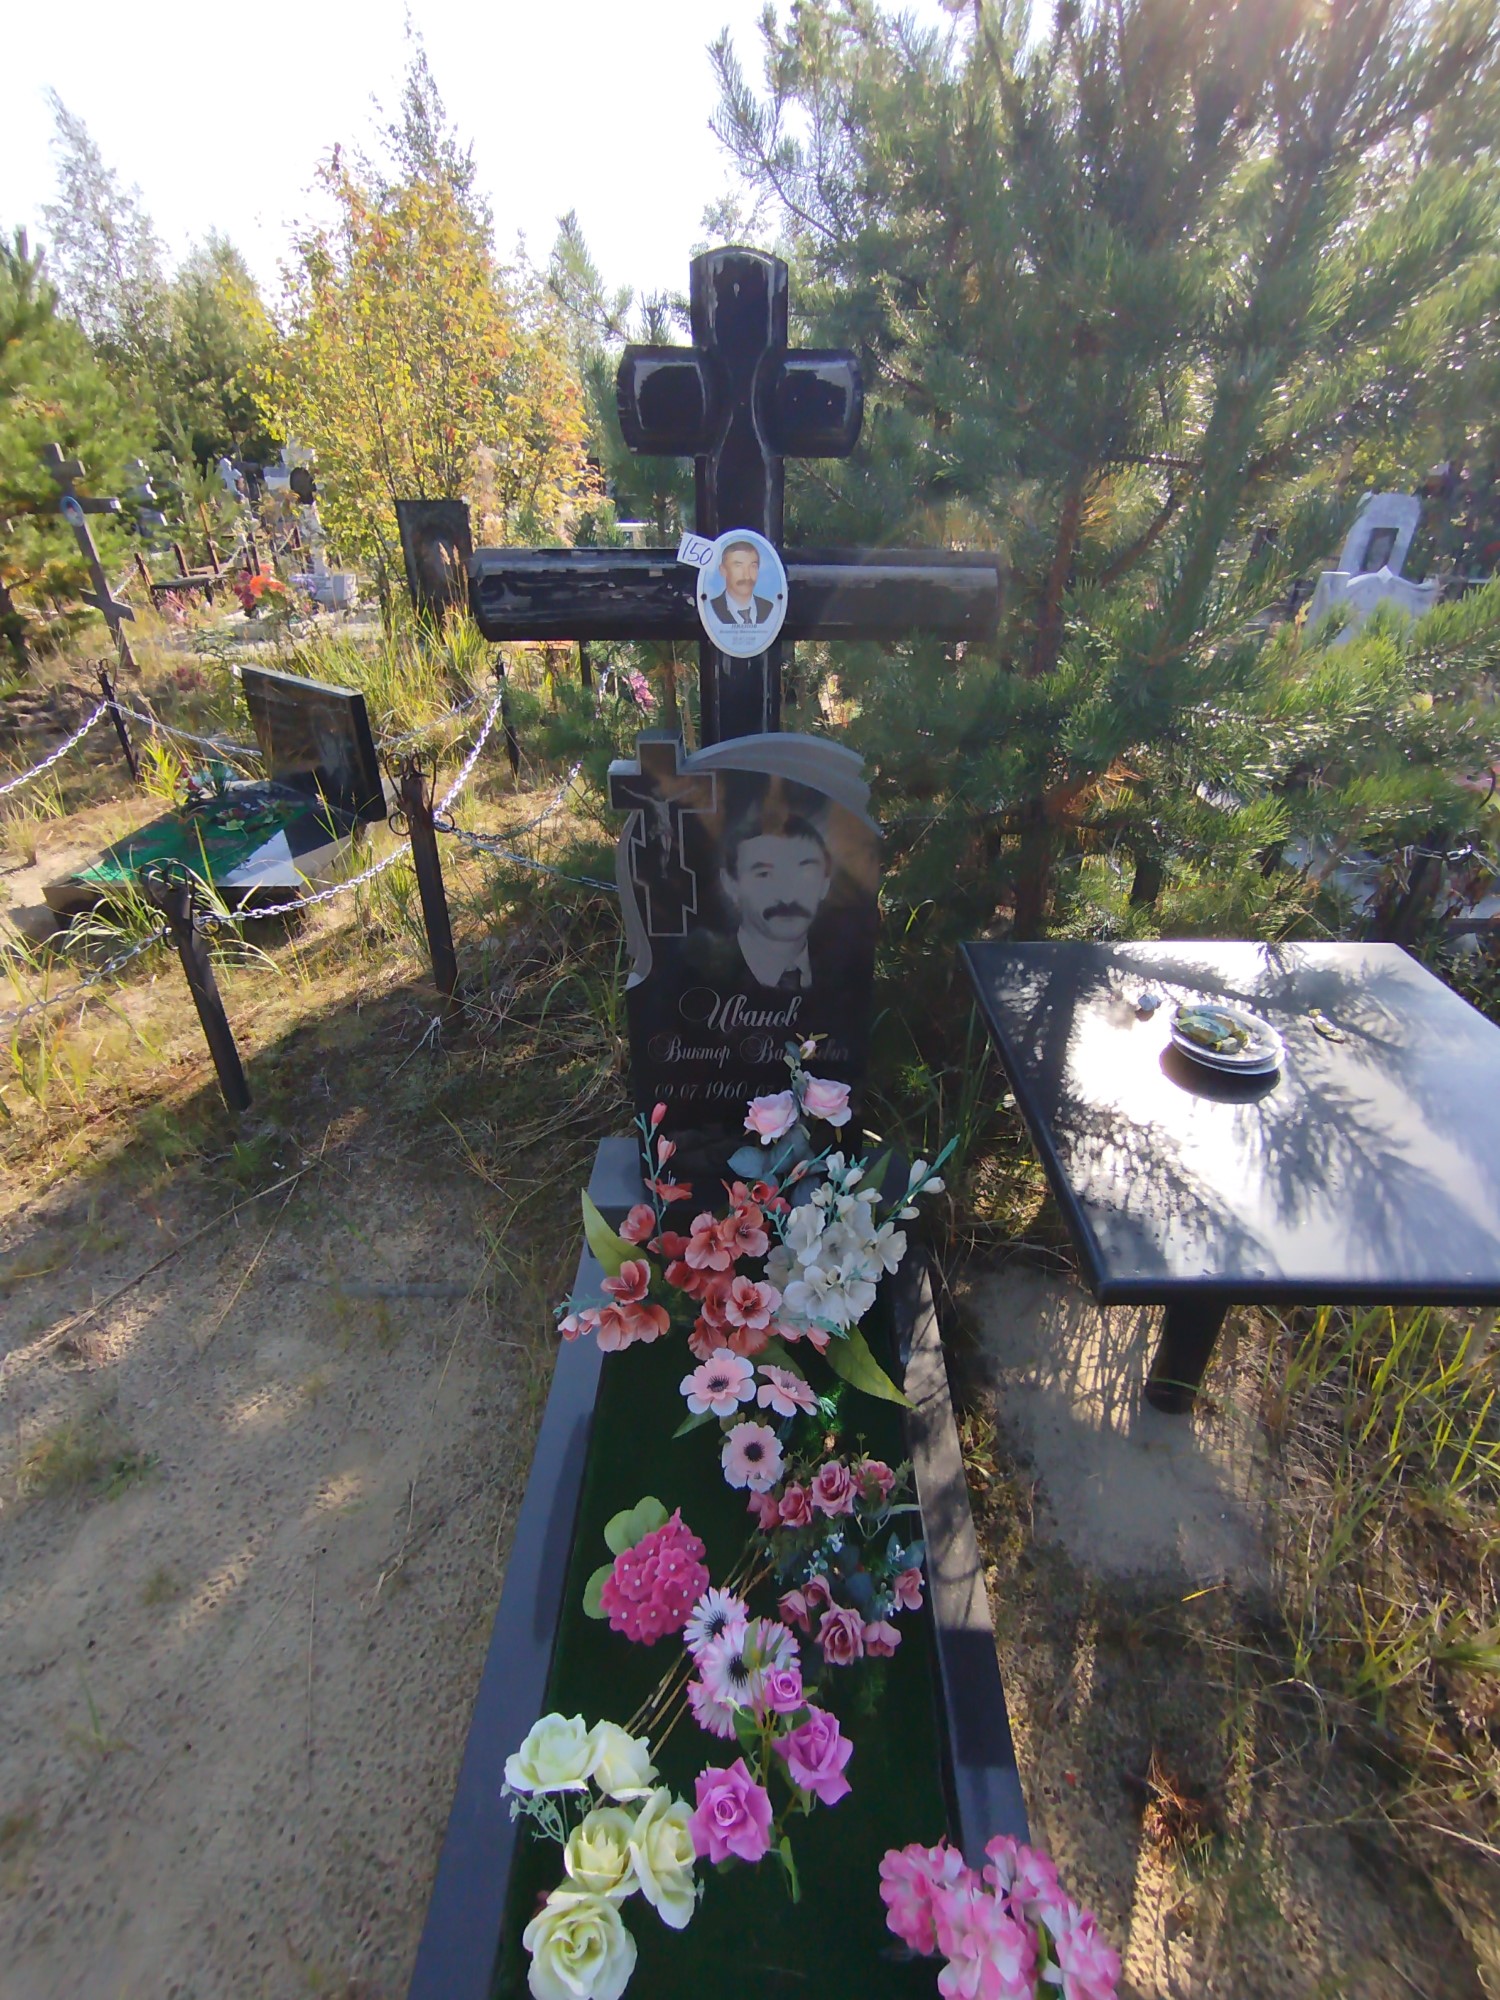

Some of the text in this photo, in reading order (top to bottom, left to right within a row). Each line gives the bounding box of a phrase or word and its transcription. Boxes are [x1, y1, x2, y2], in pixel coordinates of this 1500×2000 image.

[682, 537, 713, 566] 150
[678, 986, 802, 1033] Иванов
[648, 1032, 731, 1069] Виктор
